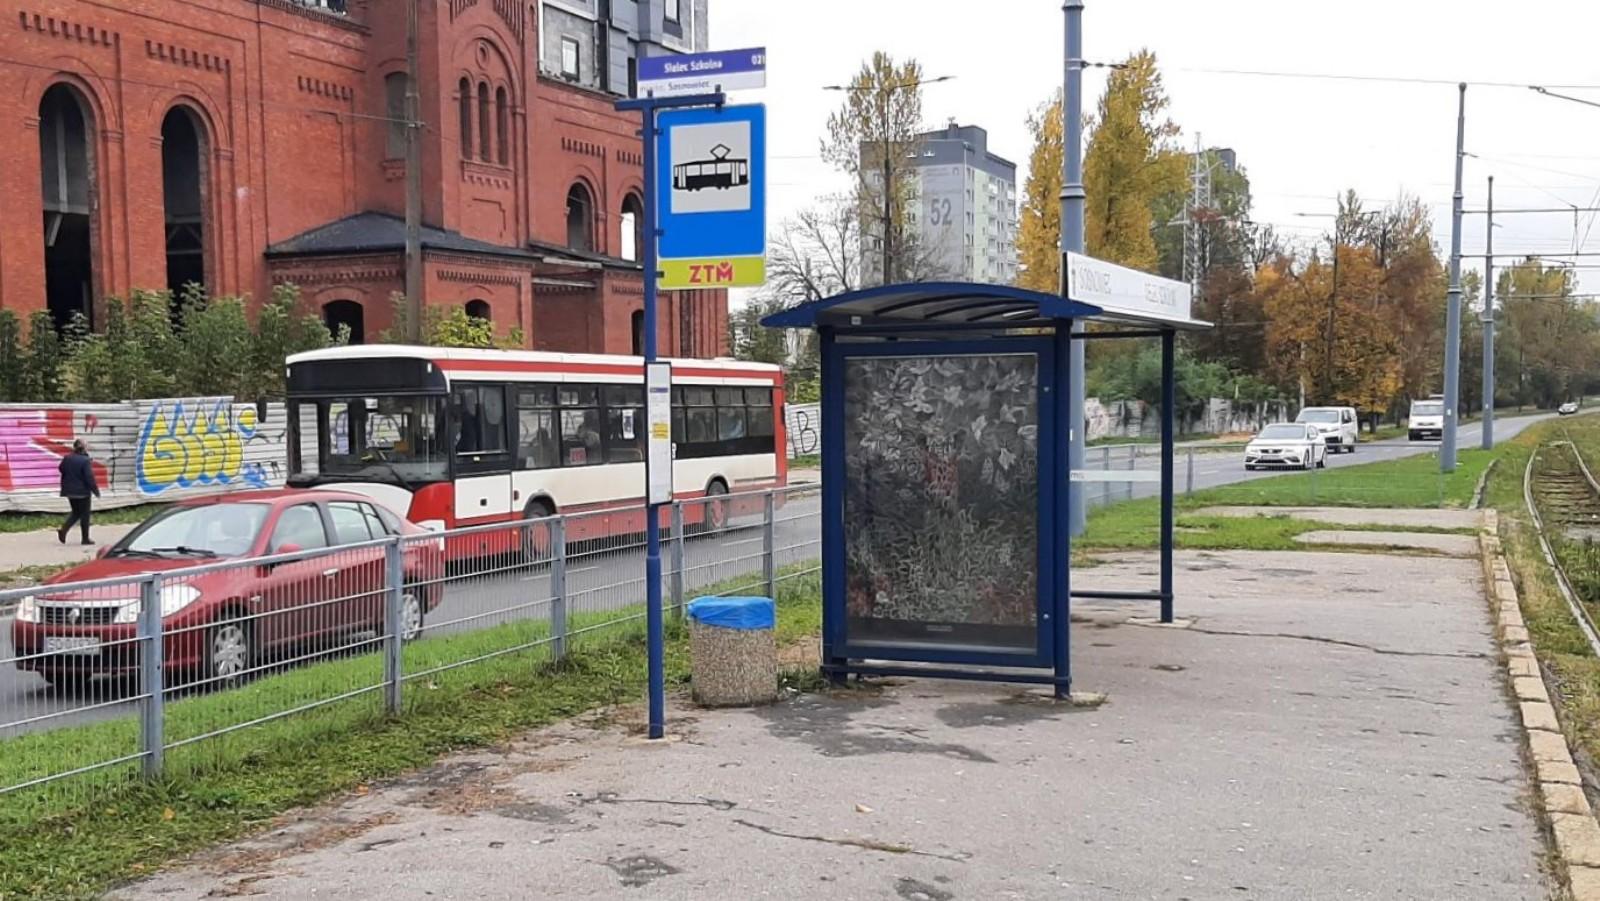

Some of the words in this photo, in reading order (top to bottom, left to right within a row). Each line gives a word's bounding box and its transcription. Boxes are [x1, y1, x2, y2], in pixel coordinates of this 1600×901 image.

[690, 58, 723, 71] Szkolna
[930, 198, 953, 226] 52
[689, 262, 733, 283] ZTM
